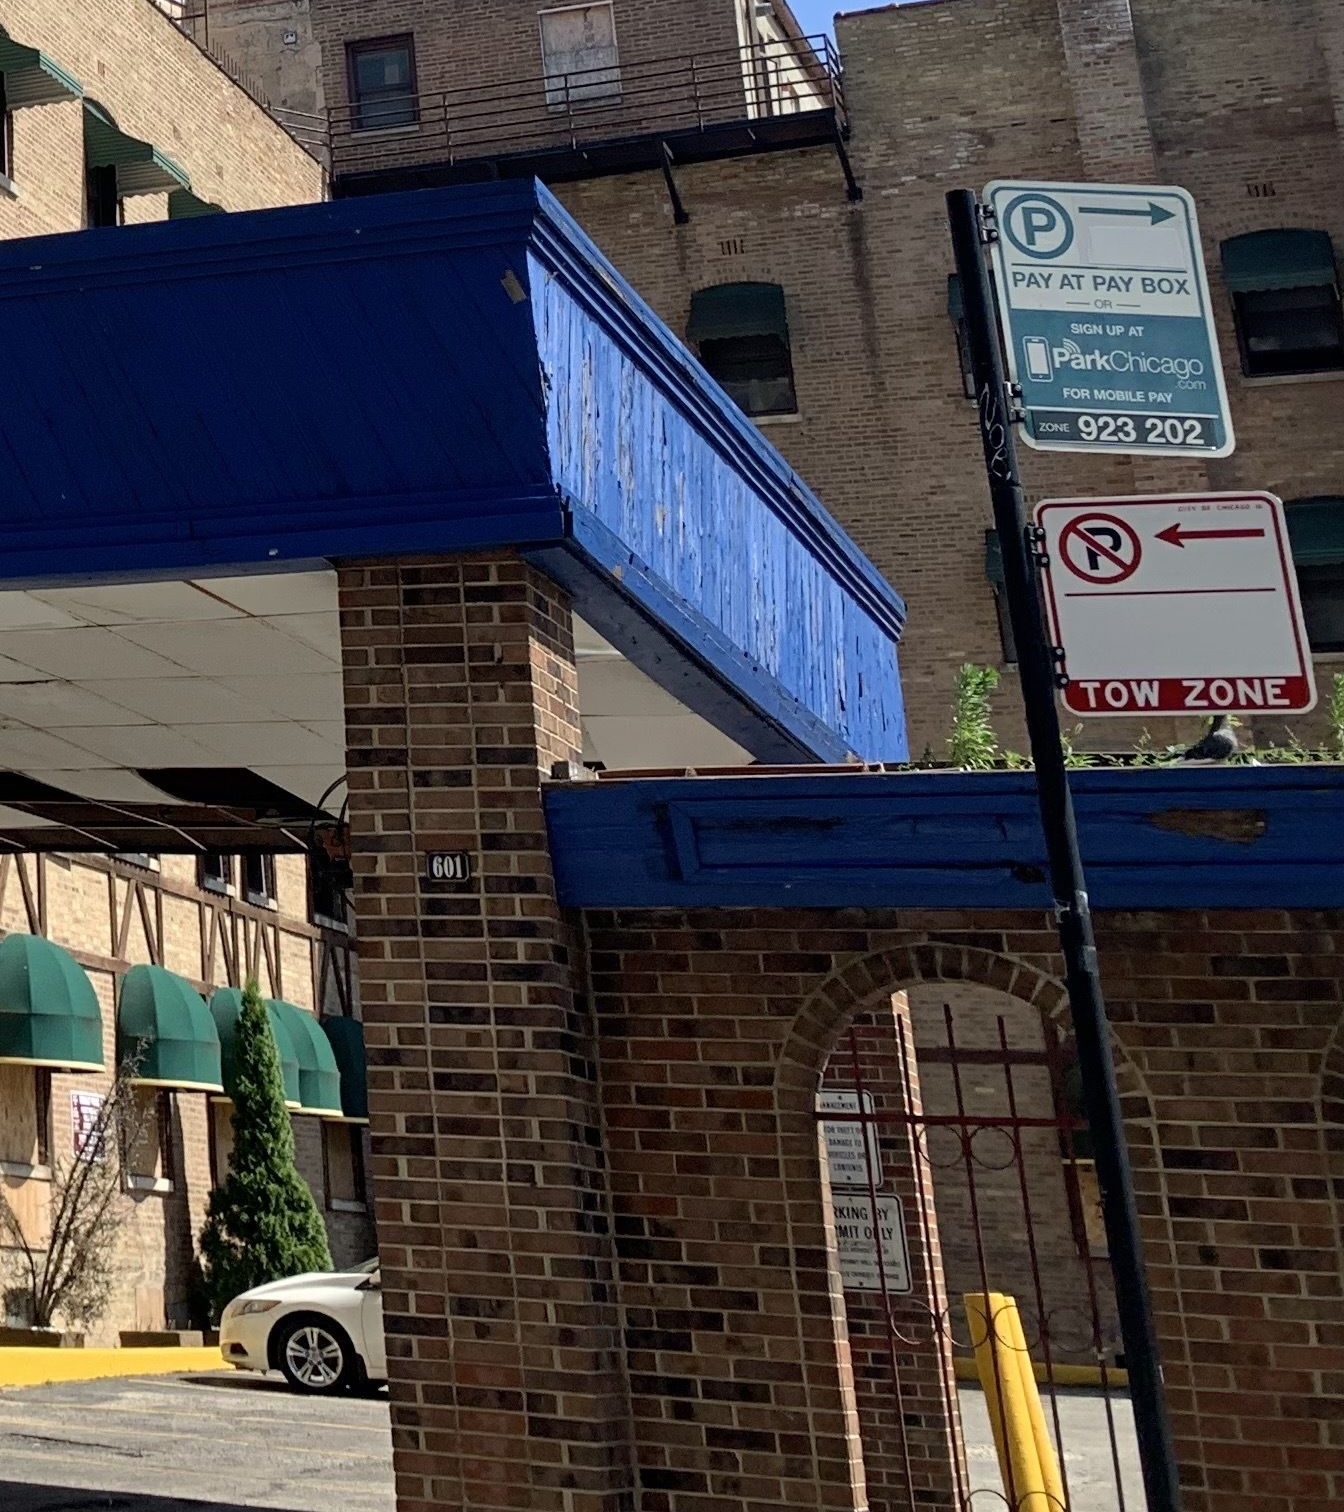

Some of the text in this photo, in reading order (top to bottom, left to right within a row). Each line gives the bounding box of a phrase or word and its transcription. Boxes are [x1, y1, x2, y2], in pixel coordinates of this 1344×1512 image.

[1012, 271, 1191, 296] PAY AT PAY BOX
[1094, 299, 1112, 309] OR
[1070, 323, 1144, 337] SIGN UP AT
[1052, 347, 1203, 380] ParkChicago
[1175, 379, 1206, 390] .com
[1063, 388, 1172, 403] FOR MOBILE PAY
[1039, 415, 1204, 445] ZONE 923 202
[1079, 678, 1290, 708] TOW ZONE
[432, 854, 463, 878] 601
[833, 1206, 868, 1220] RKING
[864, 1226, 893, 1240] OLY
